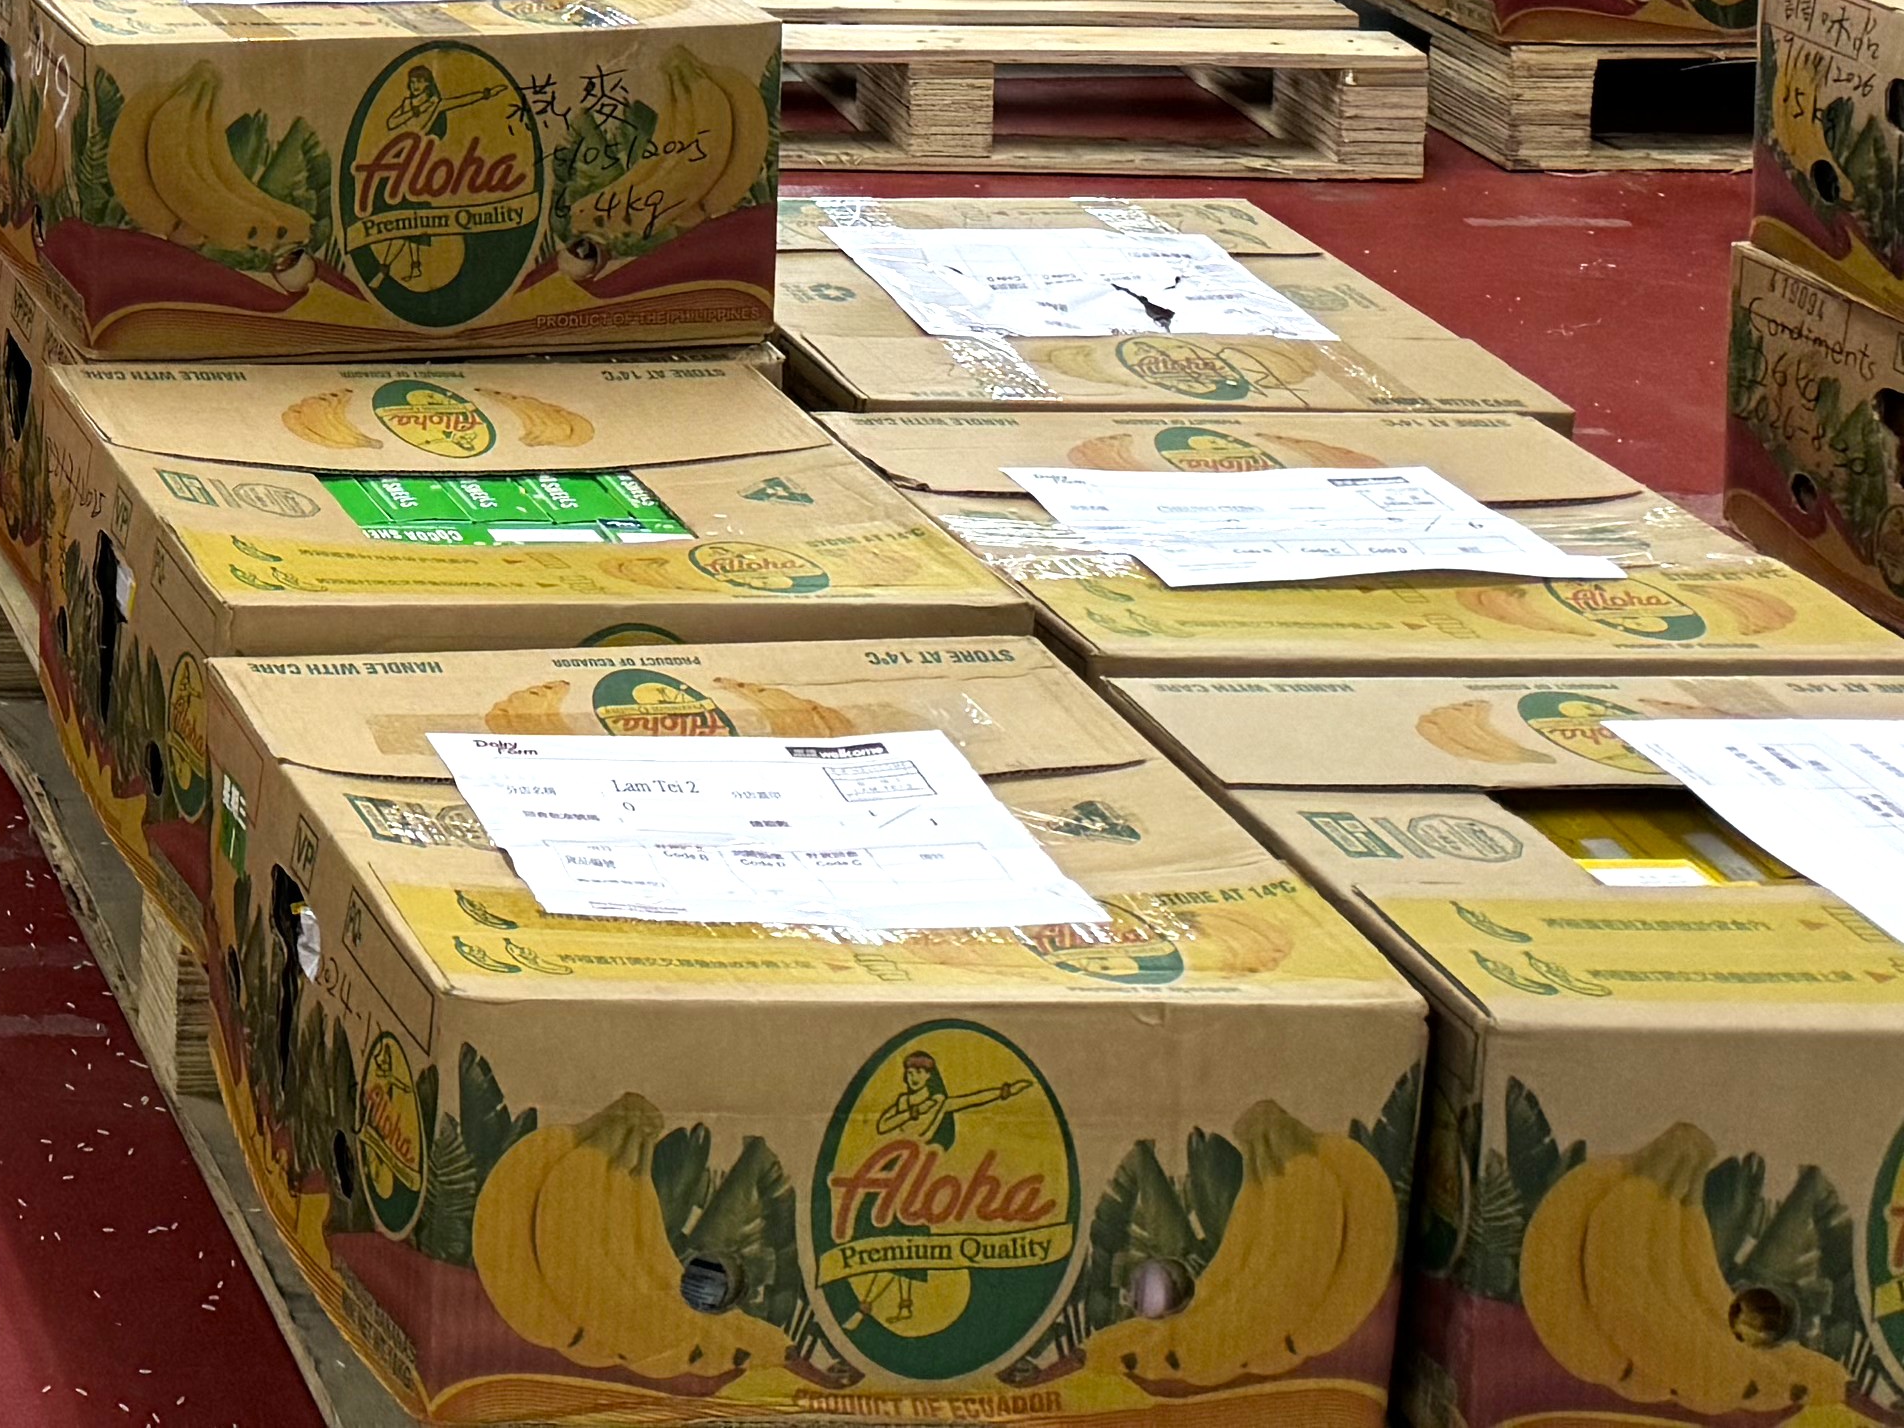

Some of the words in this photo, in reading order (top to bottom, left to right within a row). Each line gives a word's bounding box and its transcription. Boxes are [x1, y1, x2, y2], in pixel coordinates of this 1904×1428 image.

[507, 65, 638, 137] 燕麥
[355, 131, 527, 215] Aloha
[362, 212, 451, 237] Premium
[455, 203, 525, 230] Quality
[536, 314, 607, 330] PRODUCT
[667, 307, 760, 325] PHILIPPINES
[80, 369, 113, 381] CARE
[118, 369, 172, 381] WITH
[178, 369, 248, 381] HANDLE
[600, 368, 639, 382] 14°C
[640, 368, 666, 382] AT
[669, 368, 726, 382] STORE
[393, 412, 483, 434] Aloha
[406, 527, 463, 543] COCOA
[705, 556, 805, 573] Aloha
[553, 655, 616, 667] ECUADOR
[619, 655, 637, 667] OF
[641, 655, 701, 667] PRODUCT
[864, 647, 913, 665] 14°C
[918, 647, 943, 665] AT
[948, 647, 1014, 665] STORE
[247, 661, 301, 674] CARE
[304, 661, 360, 674] WITH
[363, 661, 444, 674] HANDLE
[620, 714, 730, 737] Aloha
[473, 740, 519, 753] Dairy
[817, 744, 886, 760] wellcome
[612, 780, 648, 794] Lam
[651, 780, 681, 794] Tei
[685, 780, 700, 794] 2
[295, 829, 316, 877] VP
[832, 1135, 1057, 1235] Aloha
[839, 1234, 952, 1272] Premium
[955, 1228, 1057, 1267] Quality
[792, 1387, 906, 1418] PRODUCT
[909, 1387, 944, 1418] OF
[948, 1387, 1063, 1418] ECUADOR
